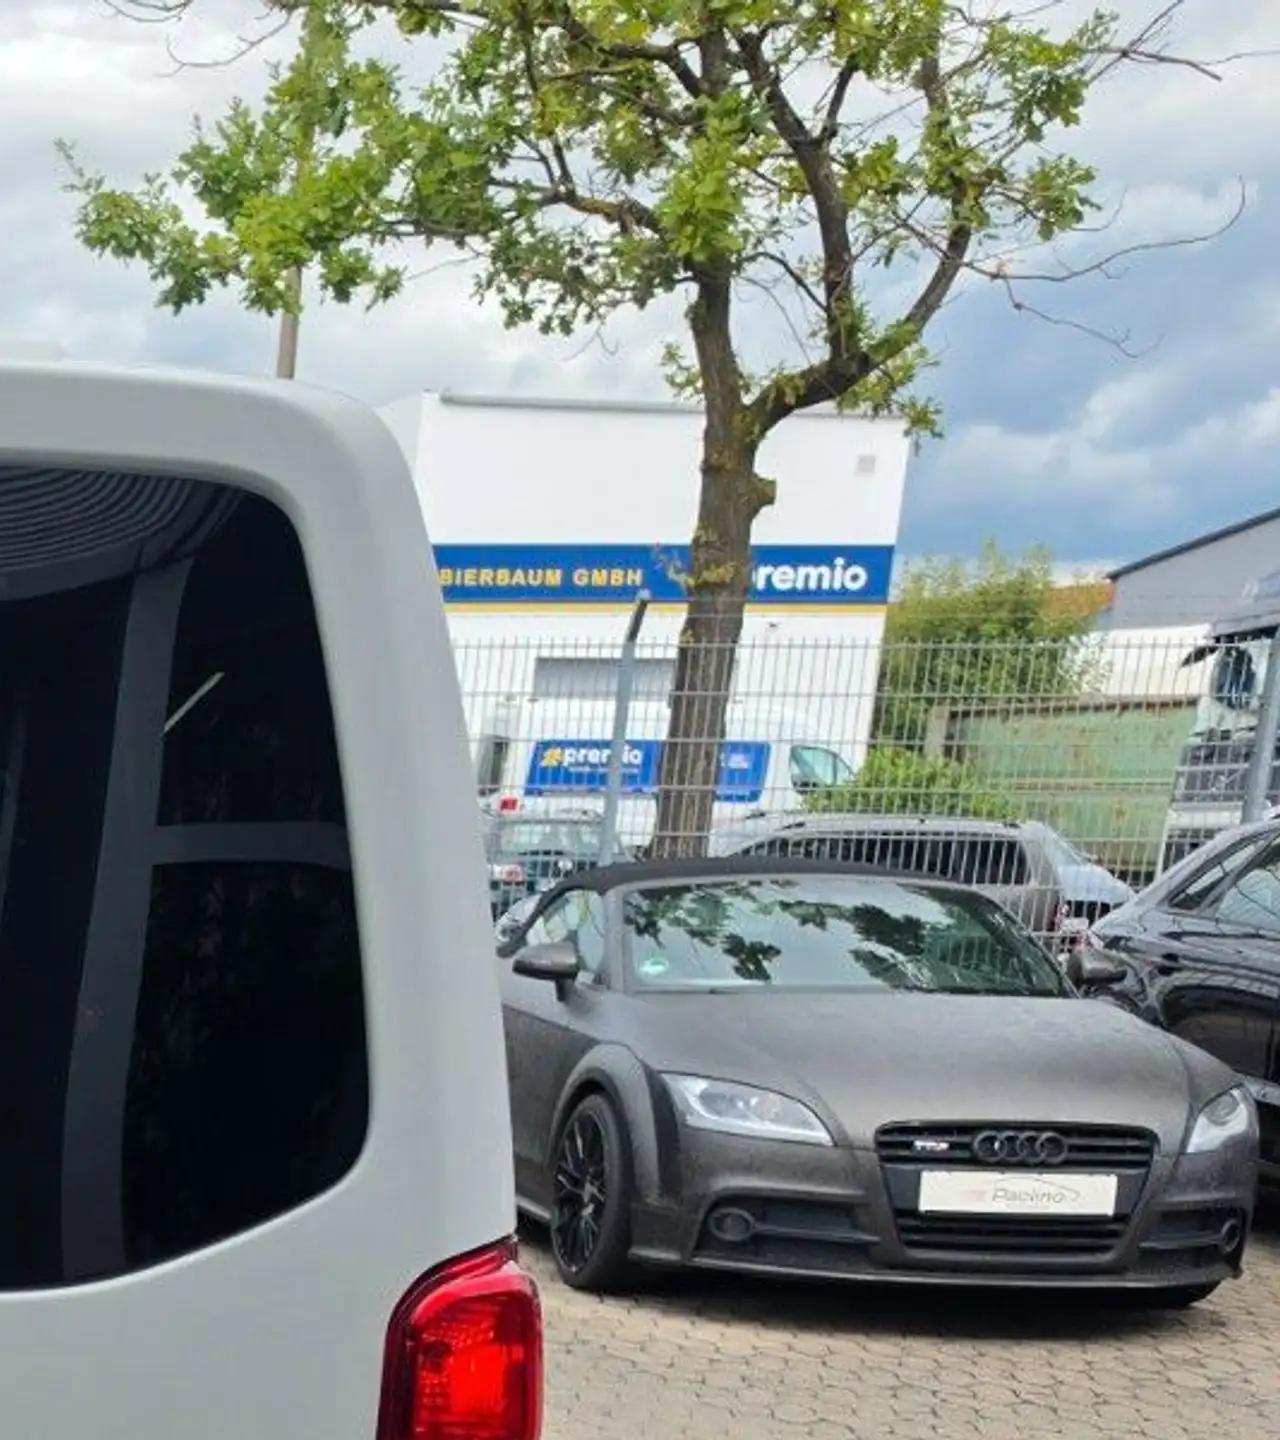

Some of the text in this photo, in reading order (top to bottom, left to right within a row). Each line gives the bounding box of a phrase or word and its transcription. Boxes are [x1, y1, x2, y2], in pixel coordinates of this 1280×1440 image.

[439, 567, 644, 587] BIERBAUM GMBH
[751, 556, 868, 592] remio
